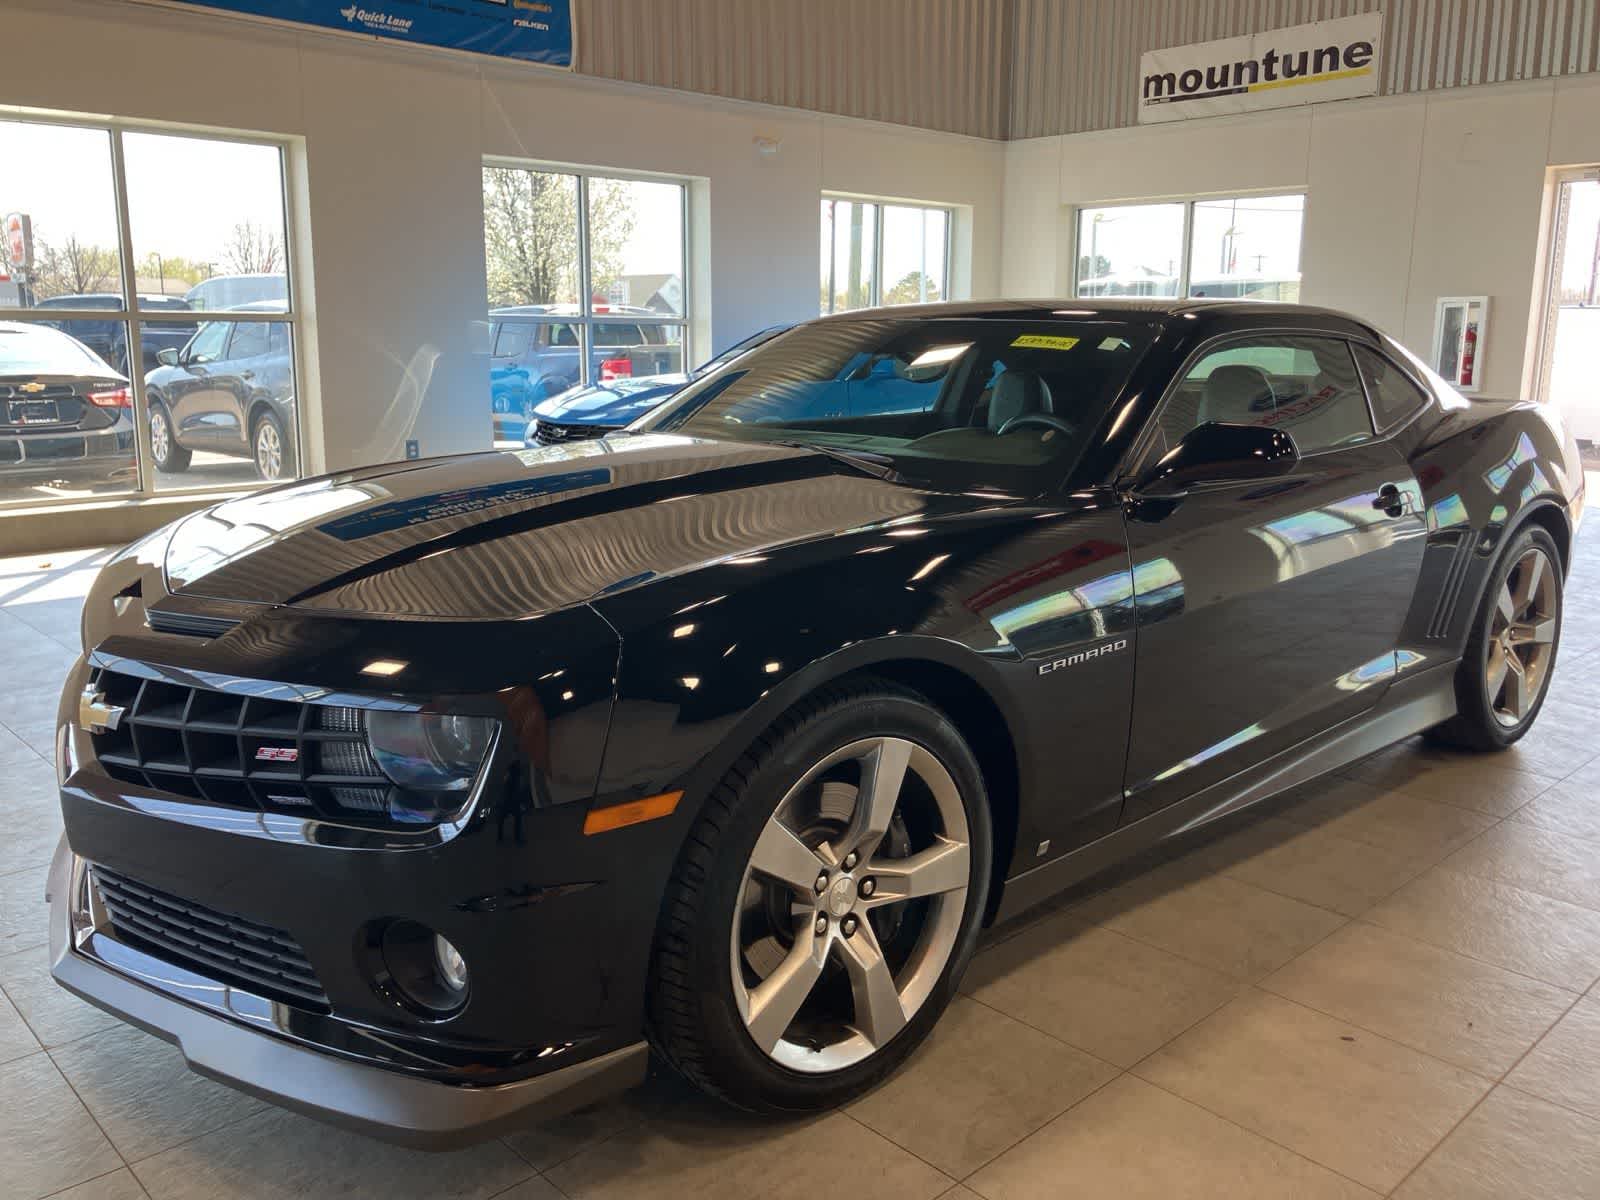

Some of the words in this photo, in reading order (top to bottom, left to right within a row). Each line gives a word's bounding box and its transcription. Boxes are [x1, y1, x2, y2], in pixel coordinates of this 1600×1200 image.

[357, 9, 386, 23] Quick
[387, 16, 414, 28] Lane
[513, 19, 549, 31] FALKEN
[1143, 41, 1373, 98] mountune
[1039, 640, 1127, 675] CAMARO
[255, 747, 298, 762] SS
